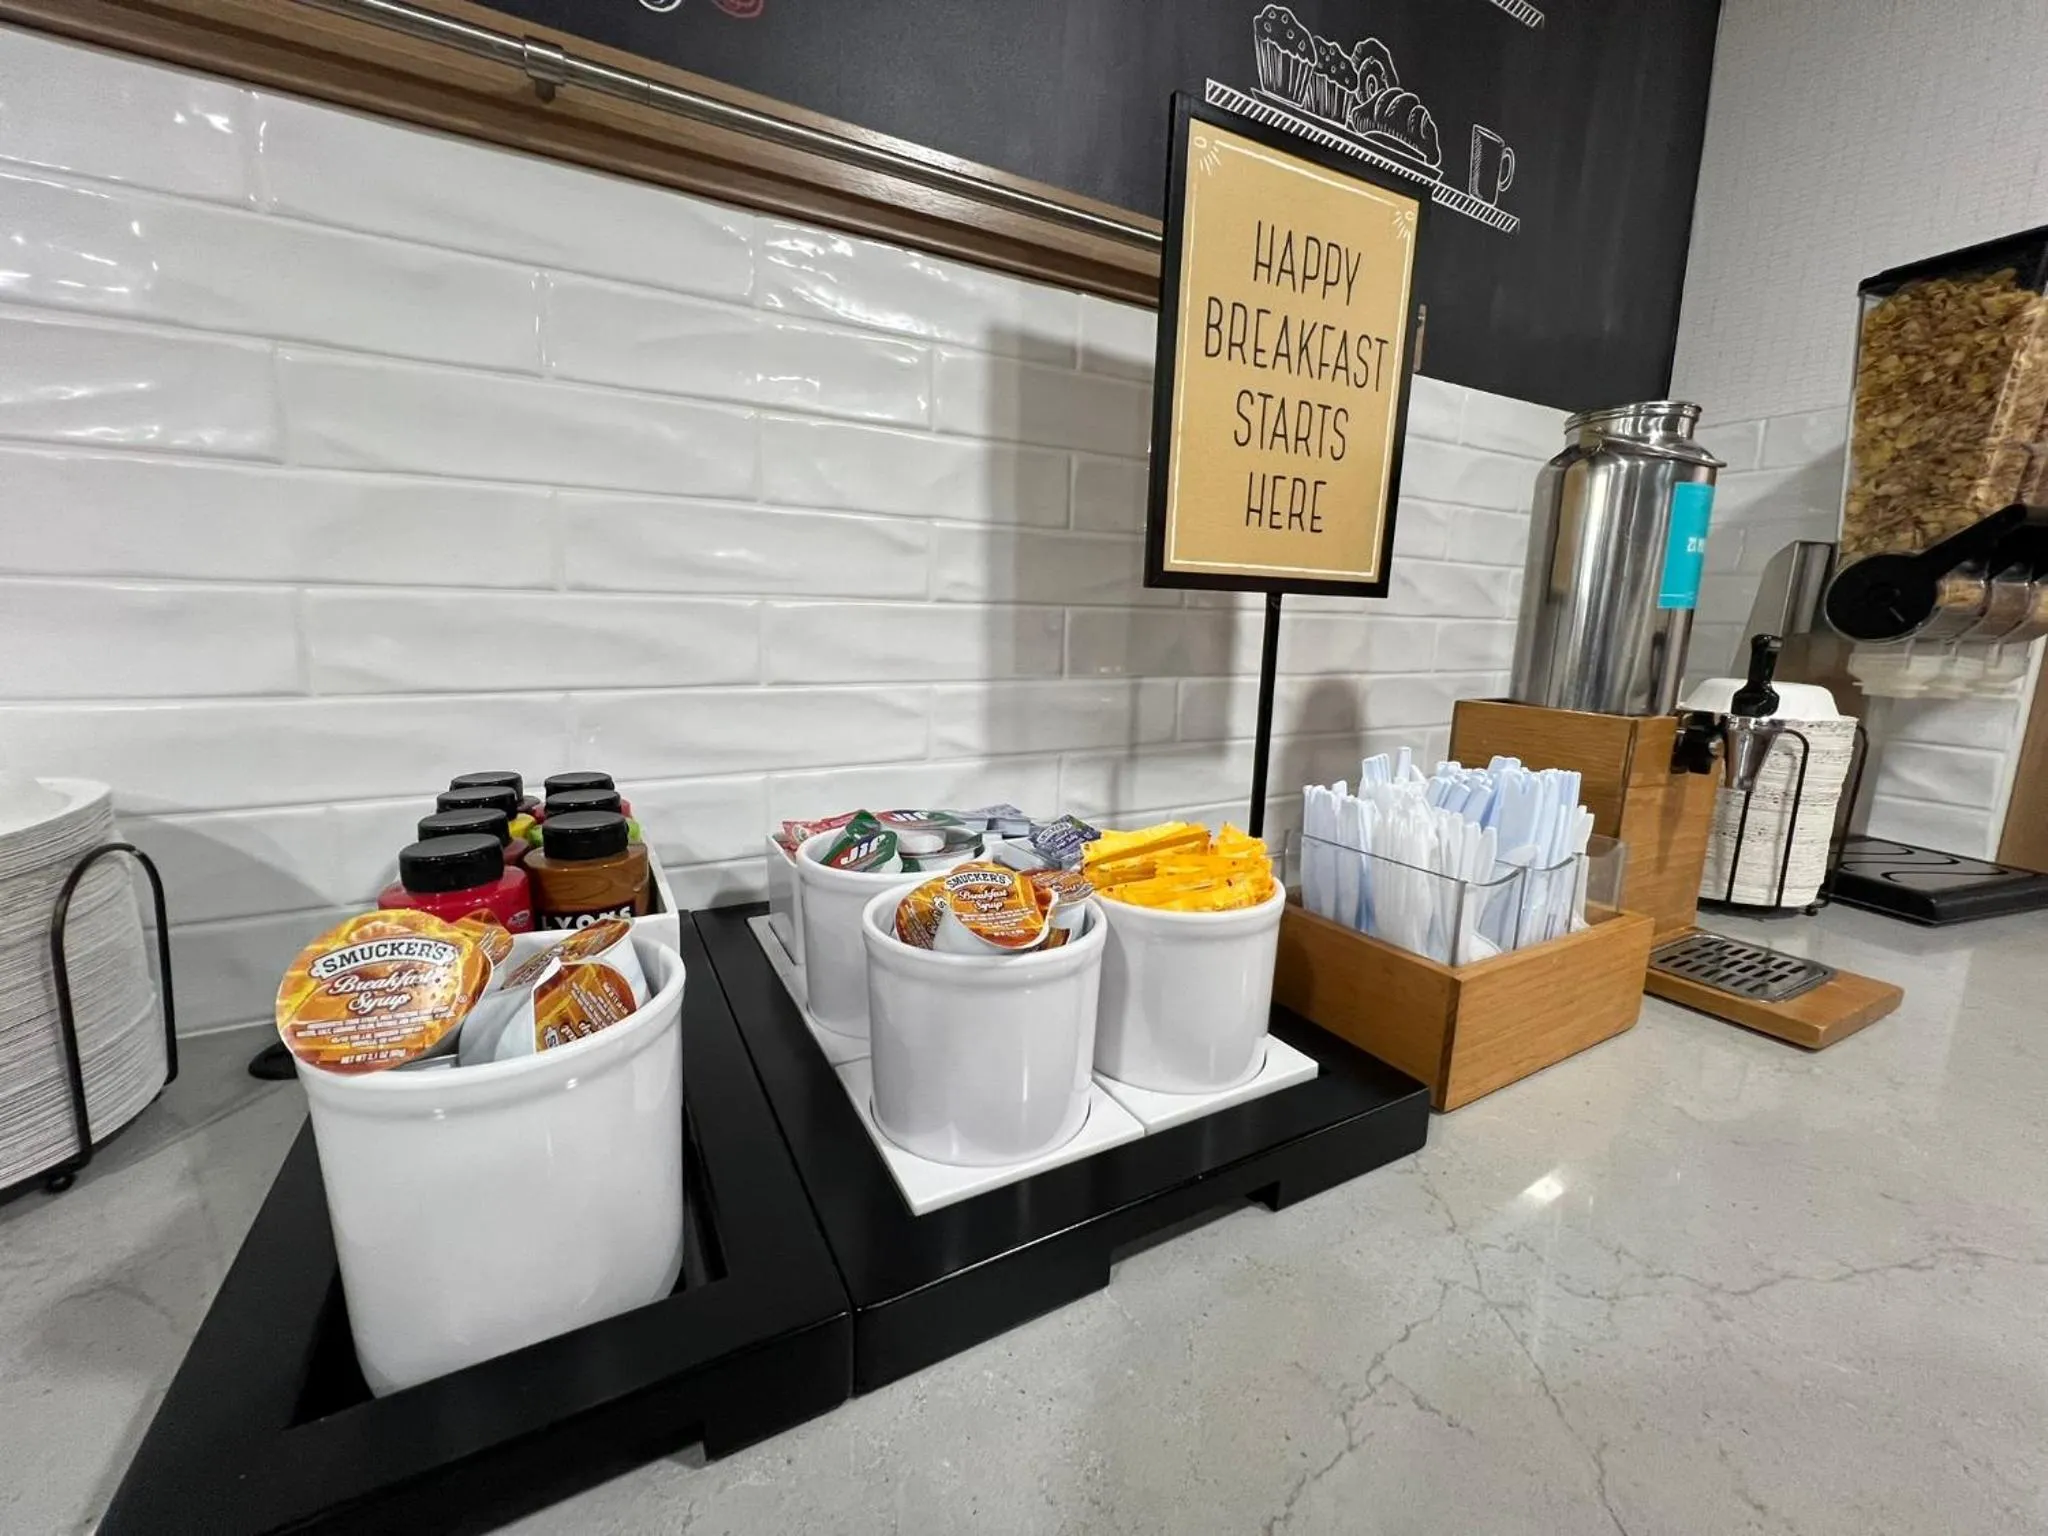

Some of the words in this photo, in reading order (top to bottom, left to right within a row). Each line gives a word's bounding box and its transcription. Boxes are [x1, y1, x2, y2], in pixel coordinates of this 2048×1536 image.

[1252, 220, 1362, 306] HAPPY
[1204, 296, 1390, 393] BREAKFAST
[1233, 389, 1350, 461] STARTS
[1245, 471, 1328, 534] HERE
[946, 872, 1008, 889] SMUCKER'S
[959, 885, 1008, 900] Breakfast
[974, 899, 1004, 914] Syrup
[322, 941, 447, 974] SMUCKER'S
[328, 967, 437, 995] Breakfast
[348, 991, 412, 1015] Syrup
